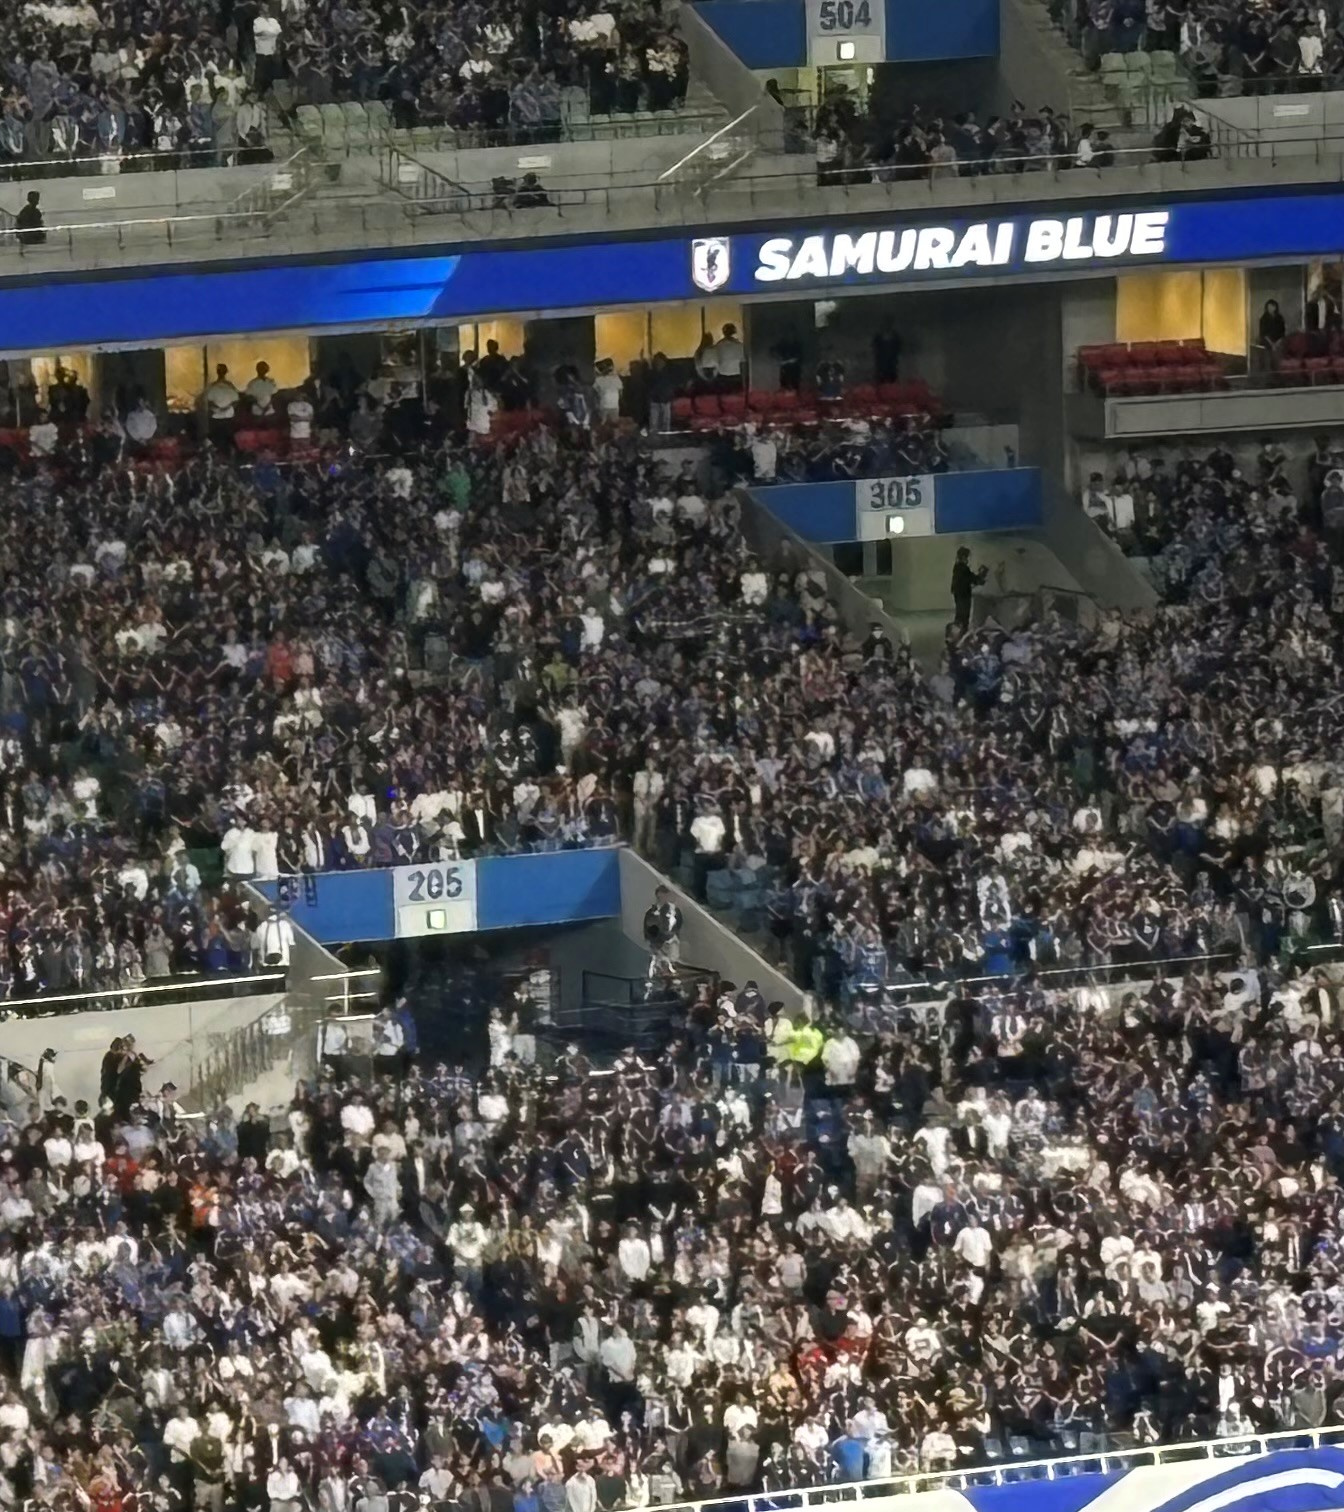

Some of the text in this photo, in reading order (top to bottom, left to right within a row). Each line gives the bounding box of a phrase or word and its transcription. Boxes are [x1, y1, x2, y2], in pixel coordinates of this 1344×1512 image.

[820, 0, 871, 30] 504
[754, 211, 1170, 282] SAMURAI BLUE
[870, 478, 922, 509] 305
[408, 867, 462, 902] 205
